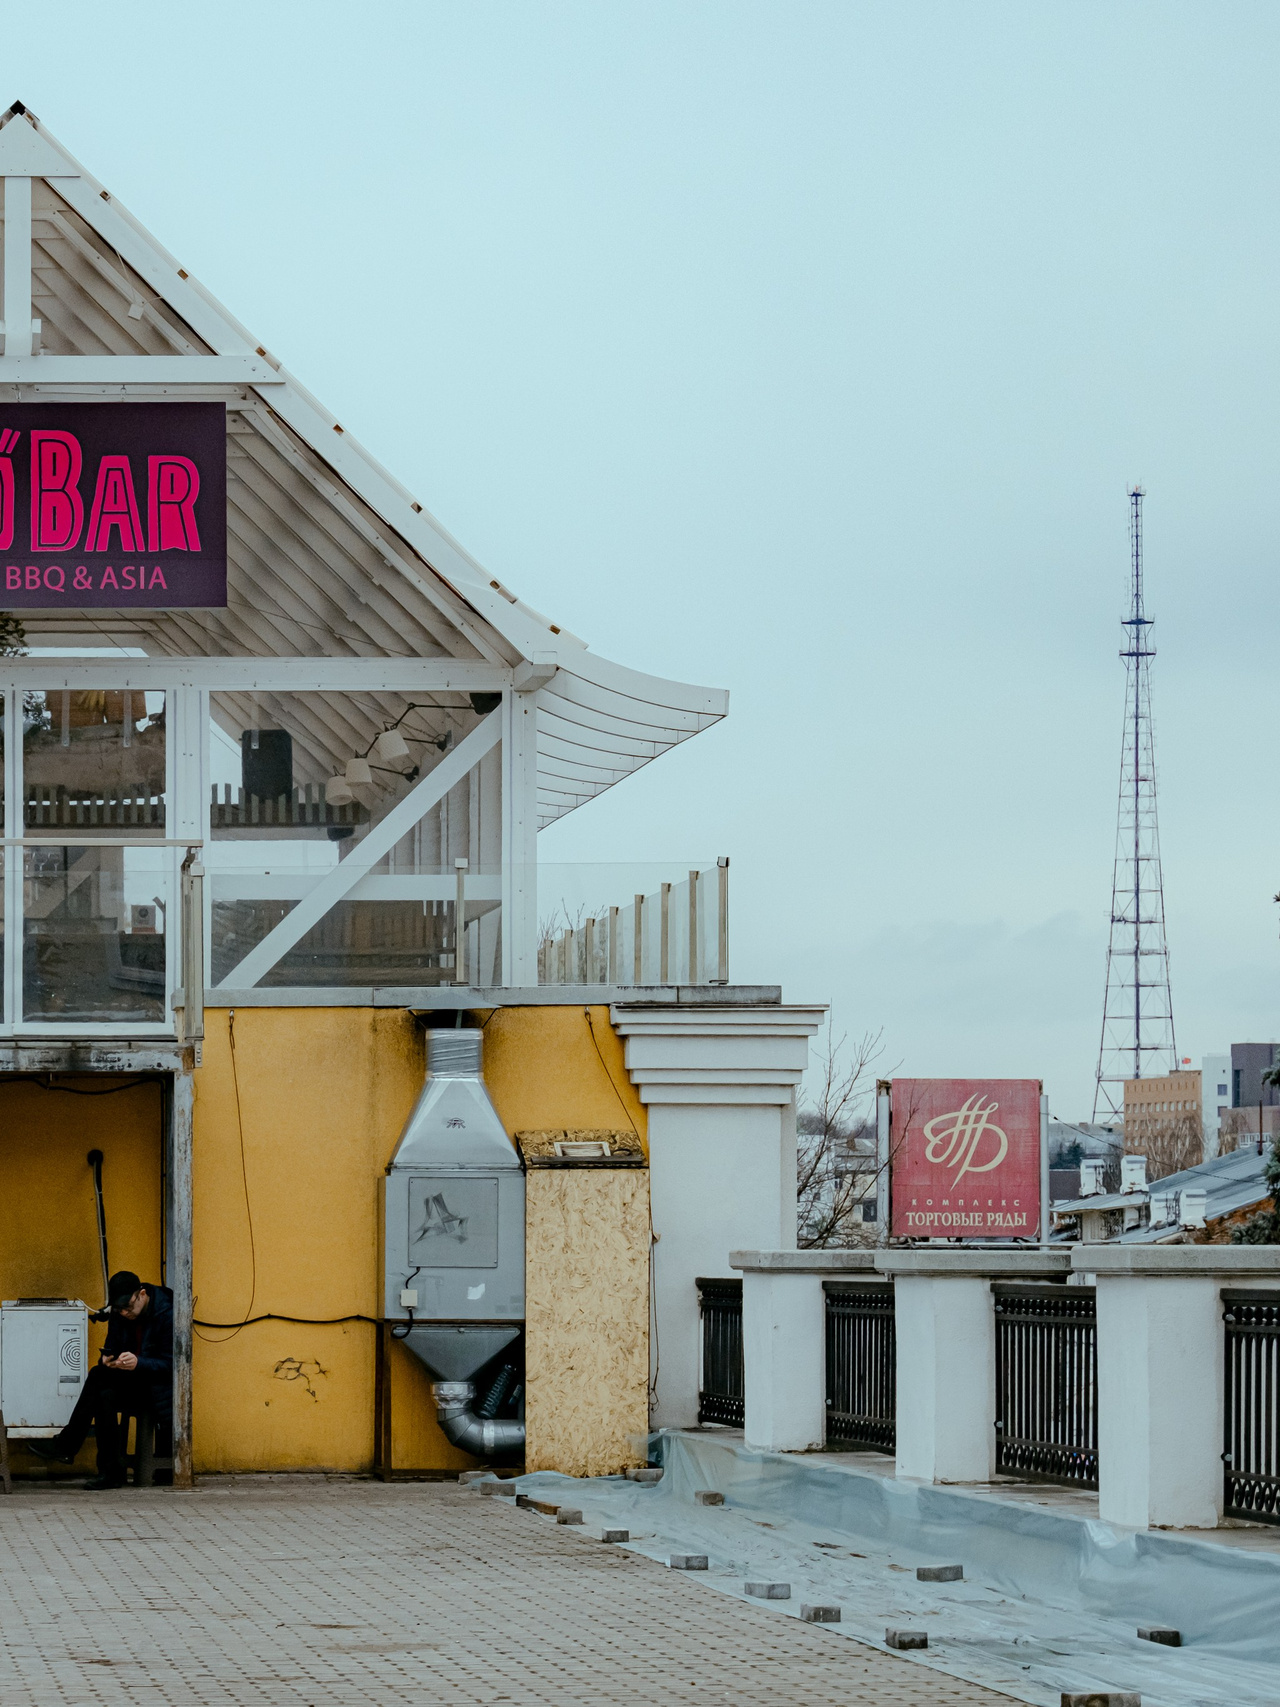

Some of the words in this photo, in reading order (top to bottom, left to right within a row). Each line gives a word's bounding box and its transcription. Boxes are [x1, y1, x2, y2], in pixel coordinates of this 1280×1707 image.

[30, 429, 202, 552] BAR
[5, 565, 66, 593] BBQ
[72, 565, 93, 591] &
[99, 564, 168, 591] ASIA
[911, 1198, 1020, 1207] КОМПЛЕКС
[905, 1211, 984, 1227] ТОРГОВЫЕ
[986, 1211, 1028, 1228] РЯДЫ
